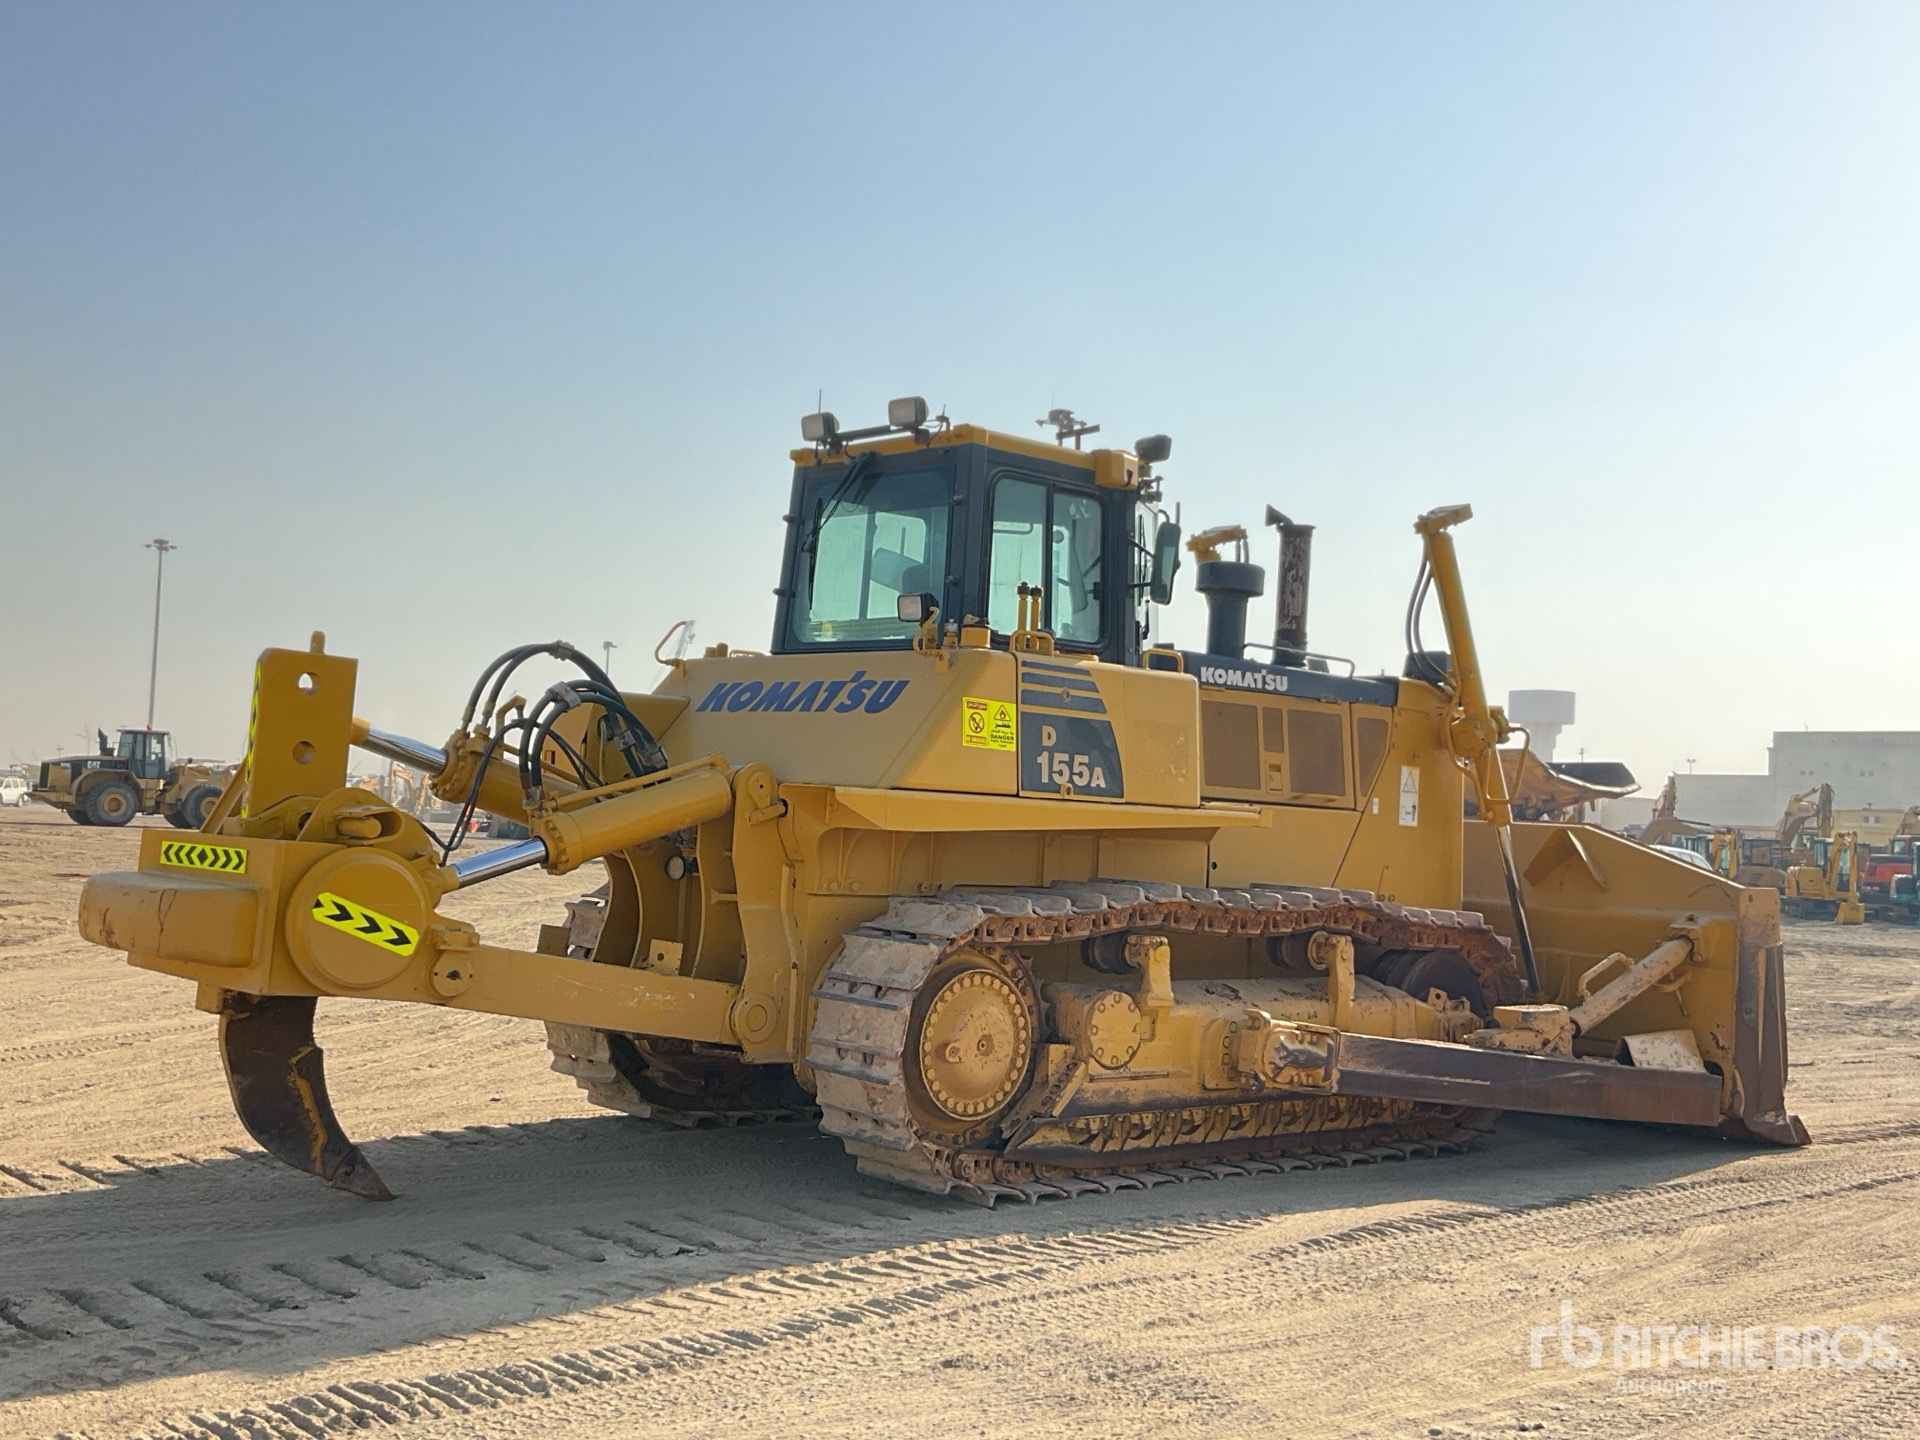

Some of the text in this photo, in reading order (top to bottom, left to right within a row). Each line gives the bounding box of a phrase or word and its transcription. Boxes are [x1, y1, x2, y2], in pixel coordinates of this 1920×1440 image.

[695, 670, 911, 714] KOMATSU
[1200, 666, 1288, 692] KOMATSU
[1042, 725, 1057, 747] D
[87, 760, 101, 769] CAT
[1036, 751, 1106, 788] 155A
